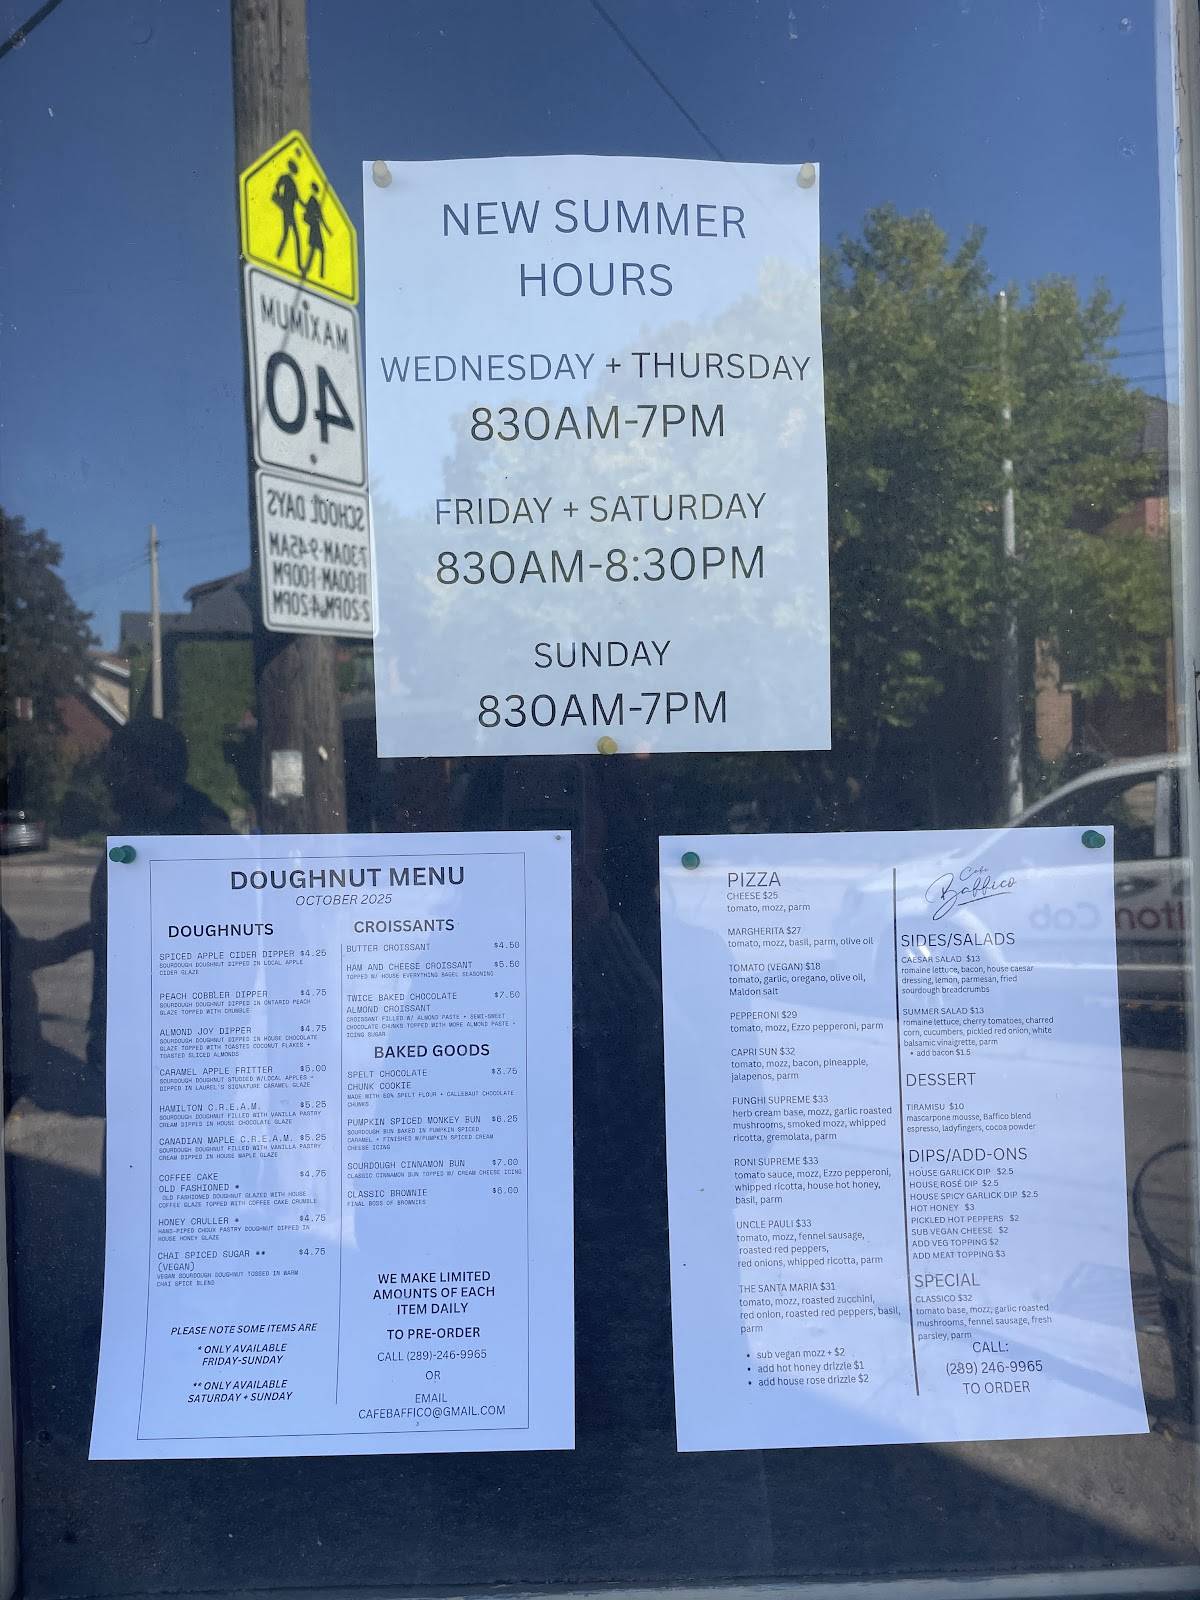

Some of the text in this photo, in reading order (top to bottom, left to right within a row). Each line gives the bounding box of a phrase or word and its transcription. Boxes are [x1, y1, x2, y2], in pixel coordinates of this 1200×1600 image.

[444, 200, 746, 237] NEW SUMMER
[520, 263, 673, 296] HOURS
[380, 352, 811, 382] WEDNESDAY + THURSDAY
[471, 405, 724, 441] 830AM-7PM
[436, 493, 766, 524] FRIDAY + SATURDAY
[437, 546, 763, 584] 830AM-8:30PM
[534, 641, 670, 668] SUNDAY
[478, 692, 726, 727] 830AM-7PM
[231, 867, 464, 889] DOUGHNUT MENU
[728, 872, 781, 887] PIZZA
[295, 894, 392, 906] OCTOBER 2025
[726, 891, 778, 900] CHEESE $25
[169, 924, 274, 938] DOUGHNUTS
[354, 919, 455, 933] CROISSANTS
[728, 926, 801, 935] MARGHERITA $27
[728, 940, 761, 948] tomato,
[789, 938, 811, 947] basil,
[814, 939, 838, 947] parm,
[862, 937, 874, 945] oil
[901, 932, 1015, 947] SIDES/SALADS
[346, 941, 520, 952] BUTTER CROISSANT $4.50
[160, 952, 192, 961] SPICED
[197, 952, 224, 960] APPLE
[262, 950, 295, 958] DIPPER
[300, 949, 327, 957] $4.25
[901, 956, 934, 964] CAESAR
[346, 960, 520, 972] HAM AND CHEESE CROISSANT $5.50
[160, 988, 327, 1000] PEACH COBBLER DIPPER $4.75
[347, 994, 373, 1002] TWICE
[378, 993, 404, 1001] BAKED
[410, 992, 457, 1000] CHOCOLATE
[730, 1010, 798, 1020] PEPPERONI $29
[375, 1044, 489, 1058] BAKED GOODS
[731, 1047, 795, 1056] CAPRI SUN $32
[906, 1072, 976, 1086] DESSERT
[160, 1100, 328, 1112] HAMILTON C.R.E.A.M. $5.25
[732, 1095, 829, 1105] FUNGHI SUPREME $33
[348, 1115, 519, 1126] PUMPKIN SPICED MONKEY BUN $6.25
[909, 1148, 1027, 1163] DIPS/ADD-ONS
[347, 1161, 396, 1170] SOURDOUGH
[400, 1160, 444, 1168] CINNAMON
[158, 1169, 327, 1182] COFFEE CAKE $4.75
[347, 1190, 385, 1198] CLASSIC
[390, 1189, 427, 1197] BROWNIE
[910, 1203, 975, 1212] HOT HONEY $3
[736, 1219, 812, 1229] UNCLE PAULI $33
[378, 1271, 491, 1284] WE MAKE LIMITED
[914, 1272, 980, 1288] SPECIAL
[373, 1286, 494, 1300] AMOUNTS OF EACH
[738, 1282, 836, 1293] THE SANTA MARIA $31
[915, 1294, 976, 1303] CLASSICO $32
[397, 1302, 468, 1315] ITEM DAILY
[171, 1323, 318, 1335] PLEASE NOTE SOME ITEMS ARE
[387, 1327, 480, 1340] TO PRE-ORDER
[972, 1341, 1009, 1353] CALL:
[202, 1356, 283, 1366] FRIDAY-SUNDAY
[377, 1349, 487, 1362] CALL (289)-246-9965
[758, 1361, 865, 1373] add hot honey drizzle $1
[946, 1360, 1043, 1376] (289) 246-9965
[426, 1370, 441, 1383] OR
[962, 1381, 1030, 1394] TO ORDER
[188, 1393, 242, 1403] SATURDAY
[250, 1392, 293, 1401] SUNDAY
[415, 1393, 448, 1403] EMAIL
[358, 1406, 505, 1419] CAFEBAFFICO@GMAIL.COM
